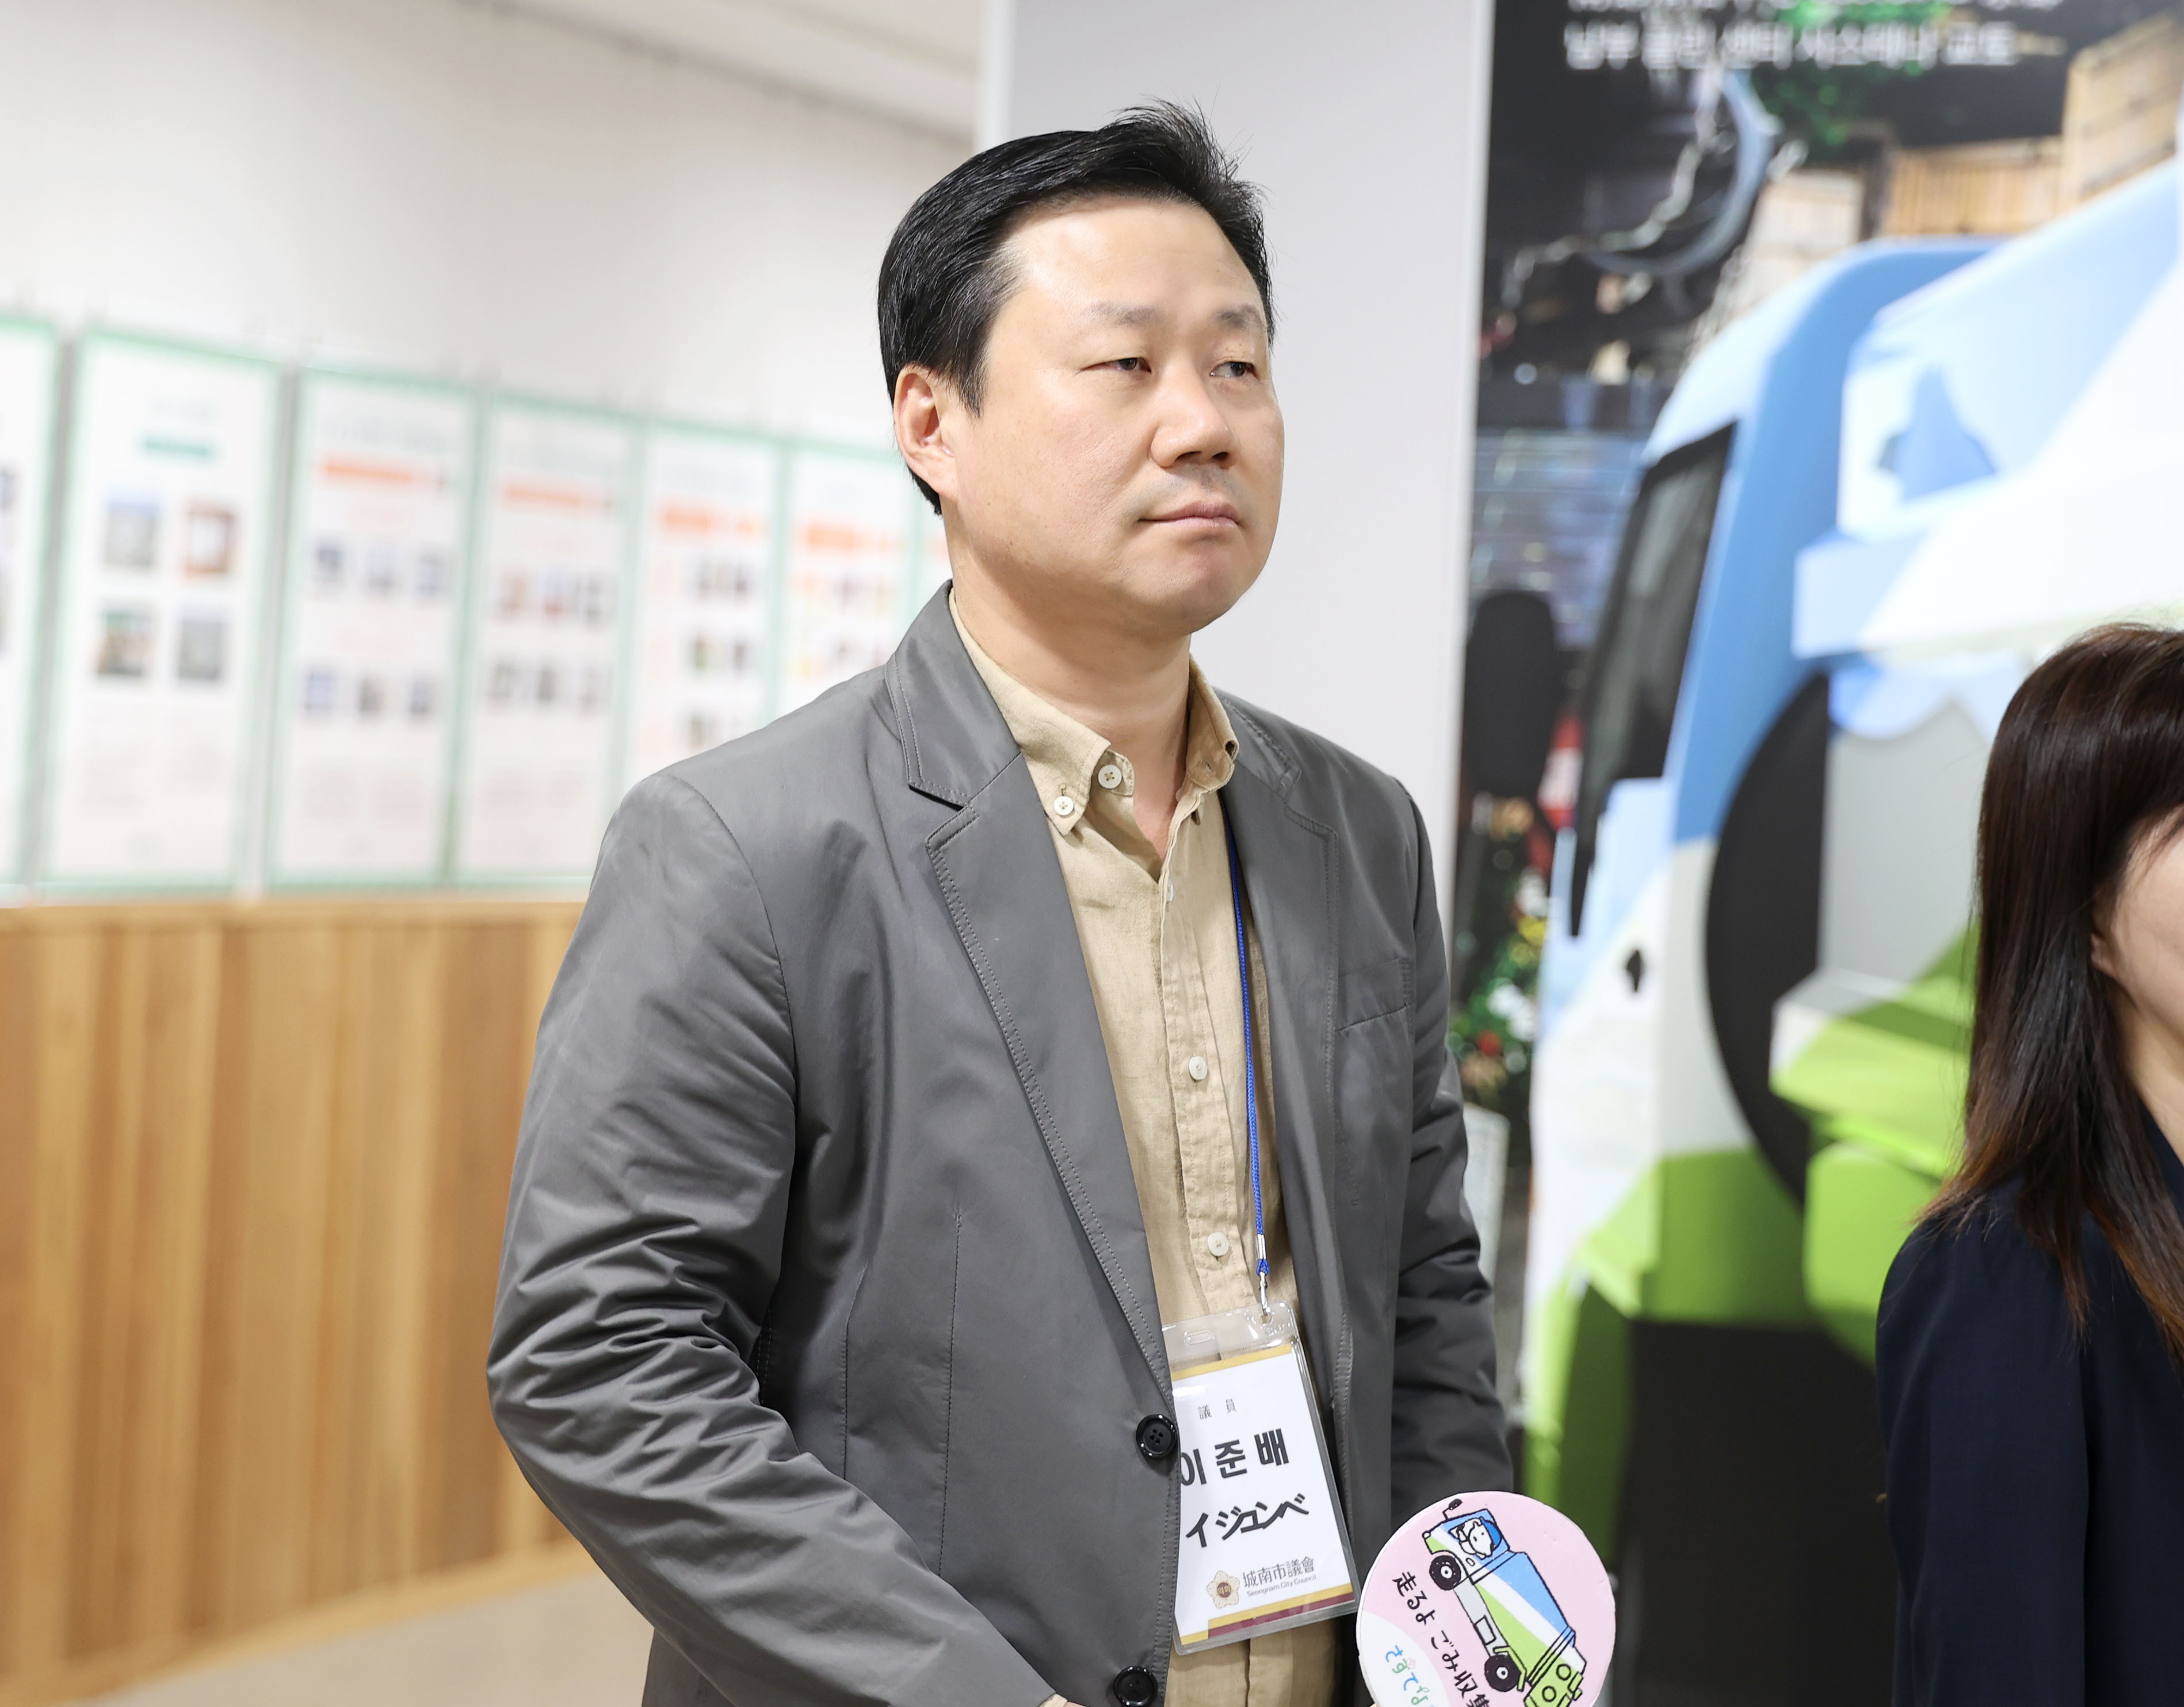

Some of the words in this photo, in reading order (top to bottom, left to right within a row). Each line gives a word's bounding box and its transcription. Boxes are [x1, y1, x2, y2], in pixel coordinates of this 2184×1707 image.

[1243, 1556, 1315, 1588] 城南市議會
[1247, 1585, 1280, 1597] Seongnam
[1280, 1580, 1293, 1588] City
[1293, 1574, 1317, 1586] Council
[1392, 1571, 1435, 1625] 走るよ
[1385, 1645, 1435, 1707] さすてな
